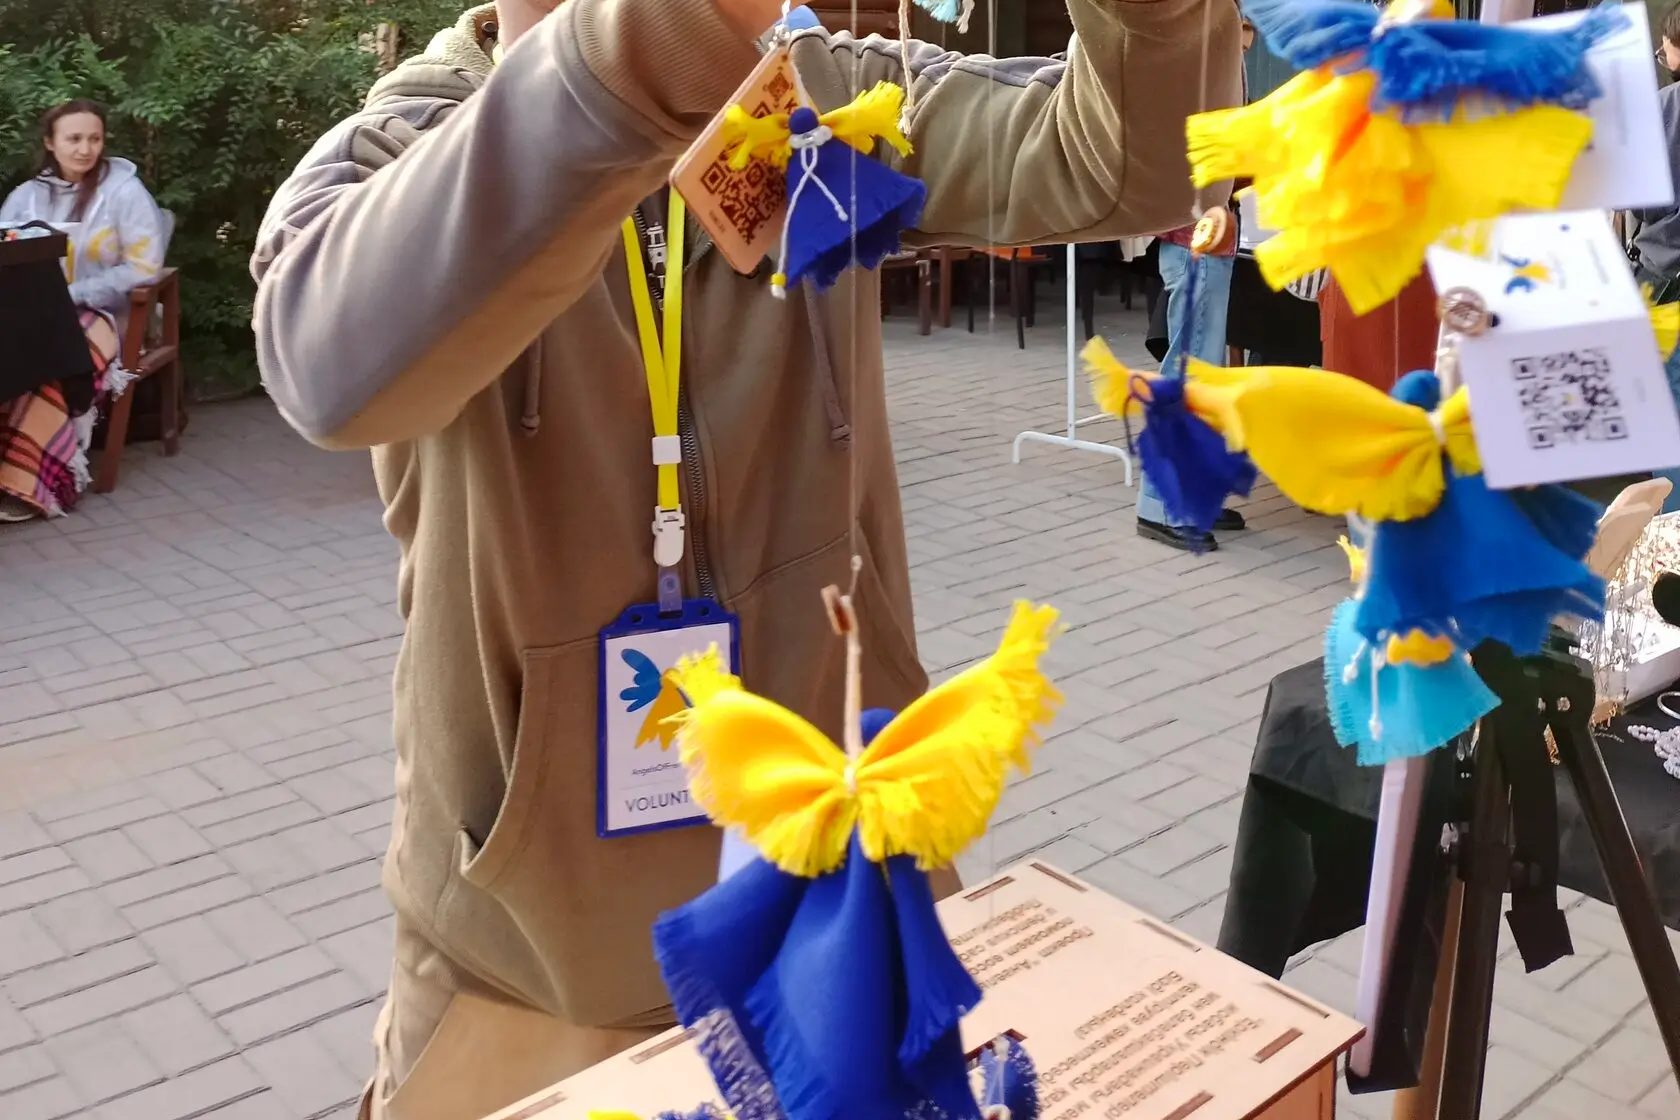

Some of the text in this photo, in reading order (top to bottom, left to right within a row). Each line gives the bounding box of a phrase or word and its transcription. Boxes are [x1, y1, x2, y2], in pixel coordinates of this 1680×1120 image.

[624, 789, 689, 813] VOLUNT
[1004, 916, 1075, 957] помогает
[1038, 926, 1094, 959] Проект
[1191, 991, 1222, 1012] мен
